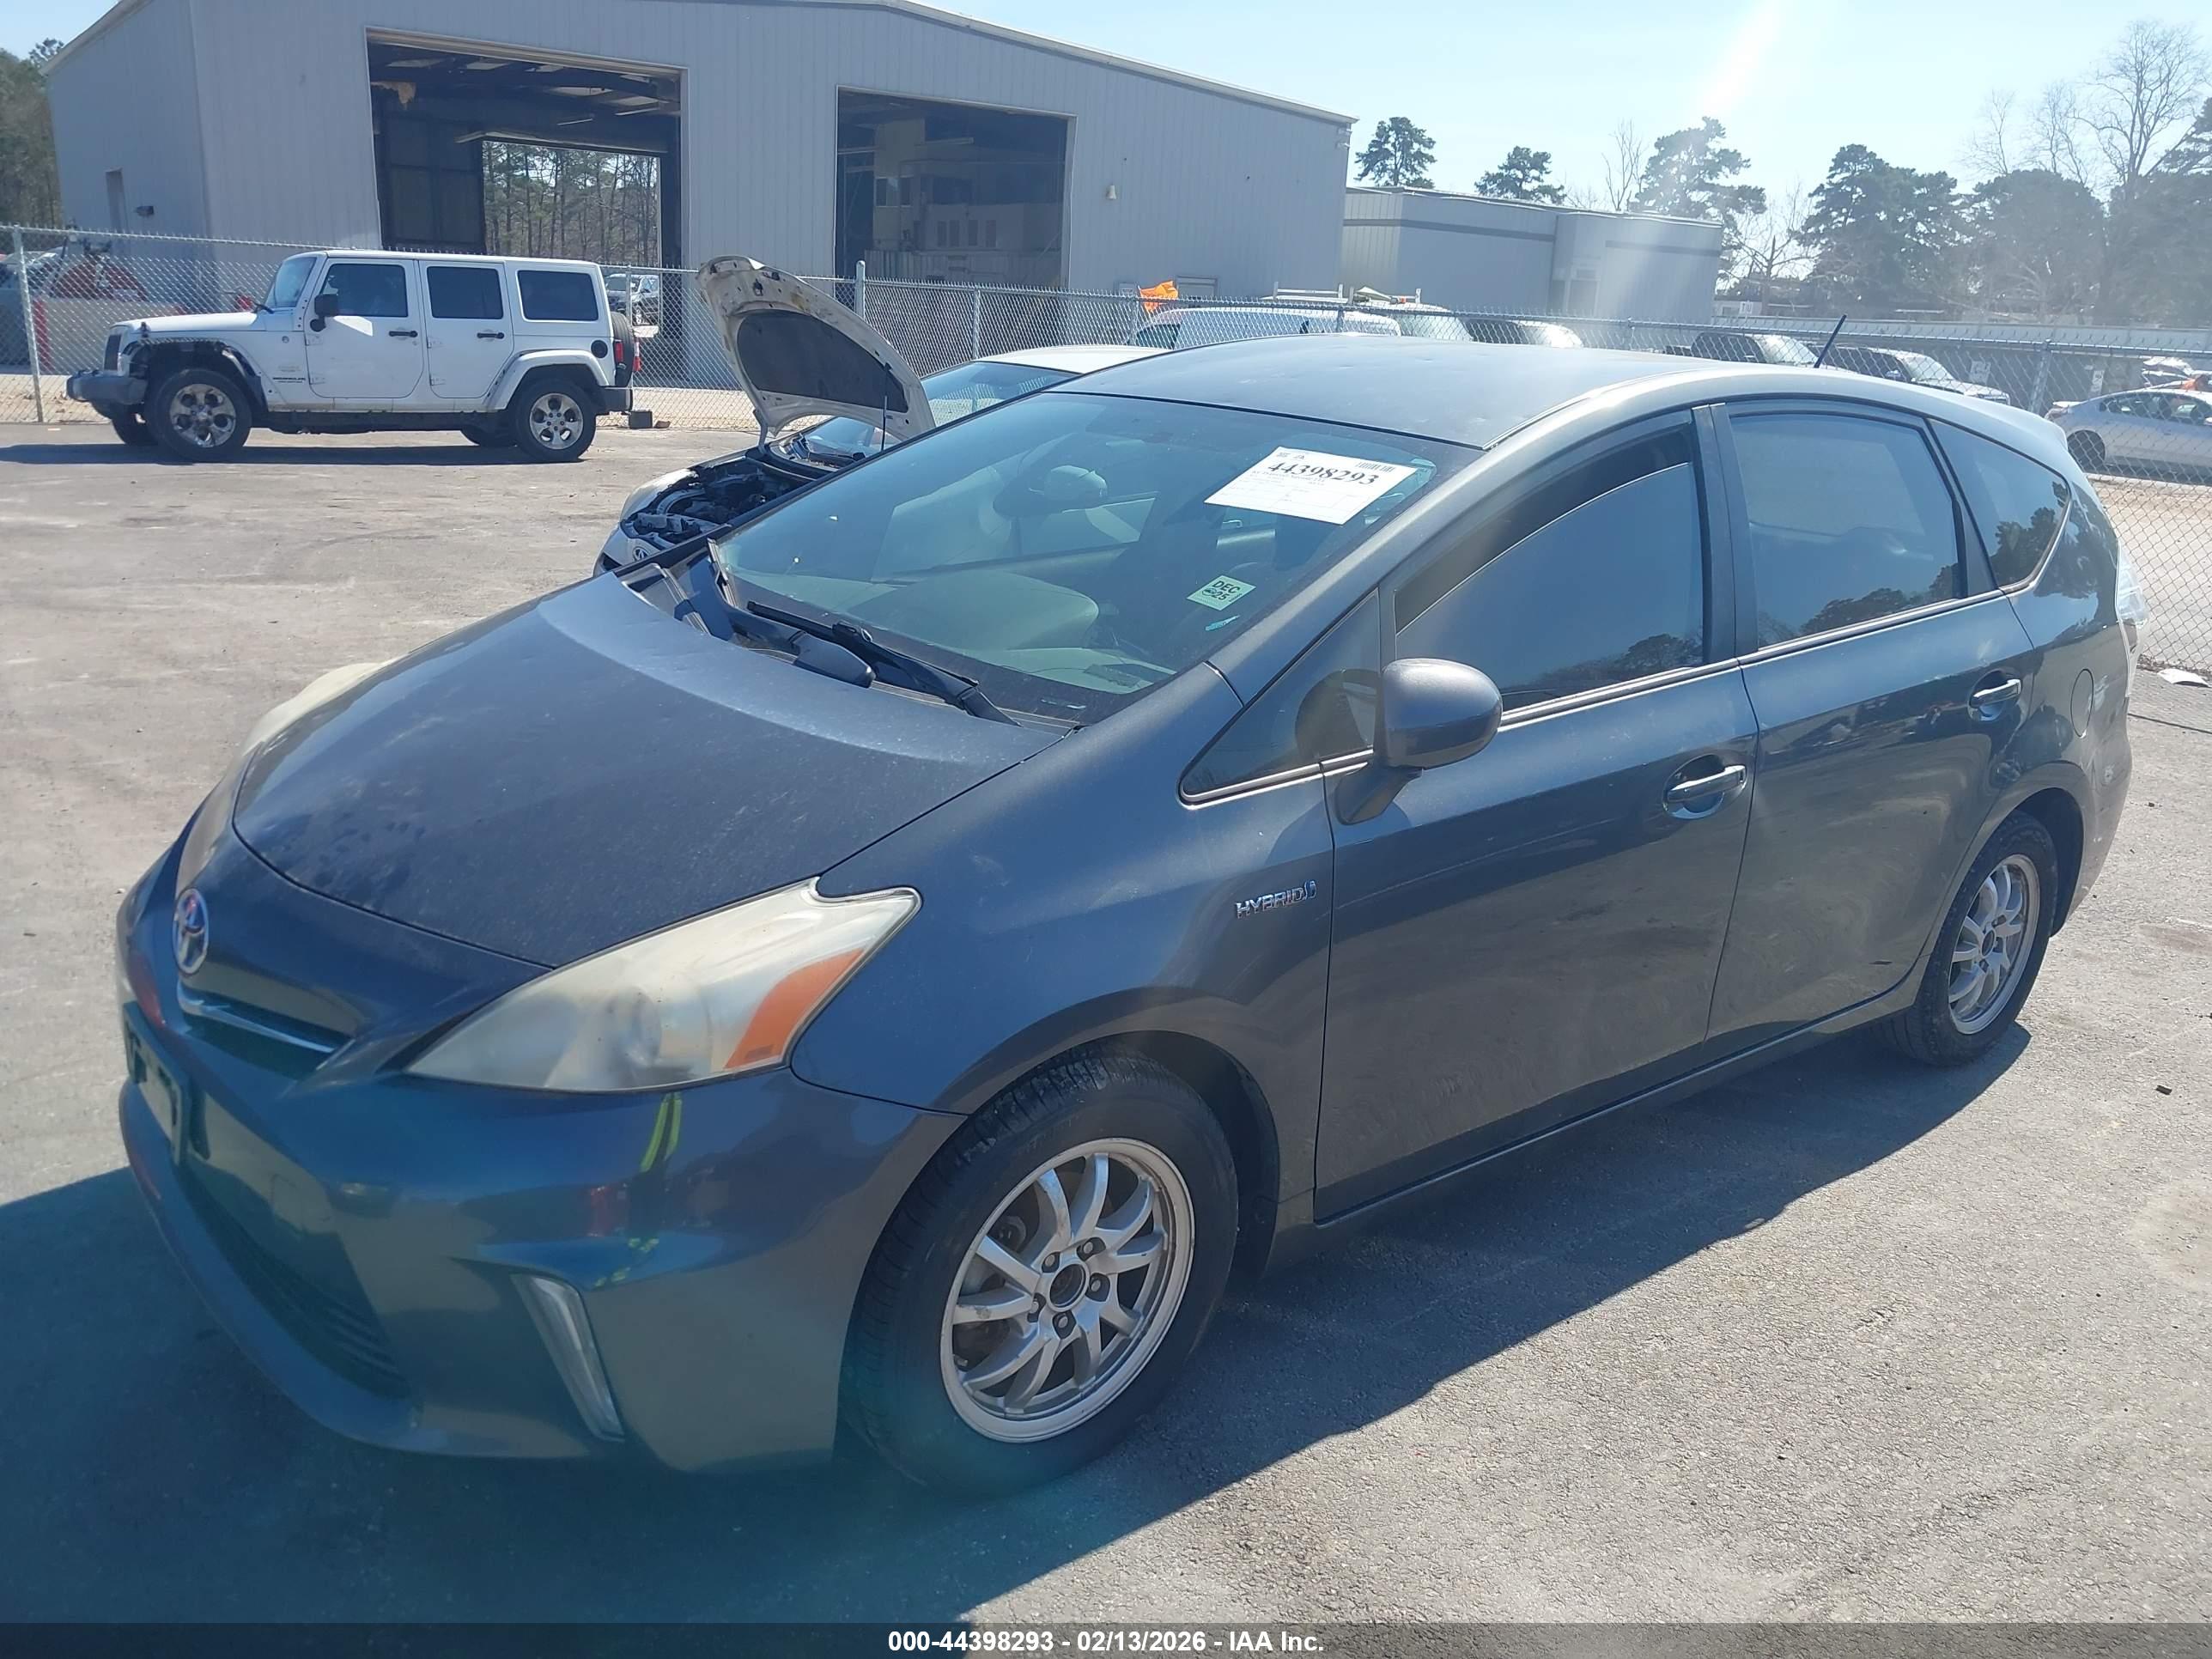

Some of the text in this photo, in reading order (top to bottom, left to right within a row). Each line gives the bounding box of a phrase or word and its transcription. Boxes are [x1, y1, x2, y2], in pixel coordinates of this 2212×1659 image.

[1267, 462, 1379, 485] 44398293
[1212, 580, 1241, 593] DEC
[1236, 887, 1304, 919] HYBRID
